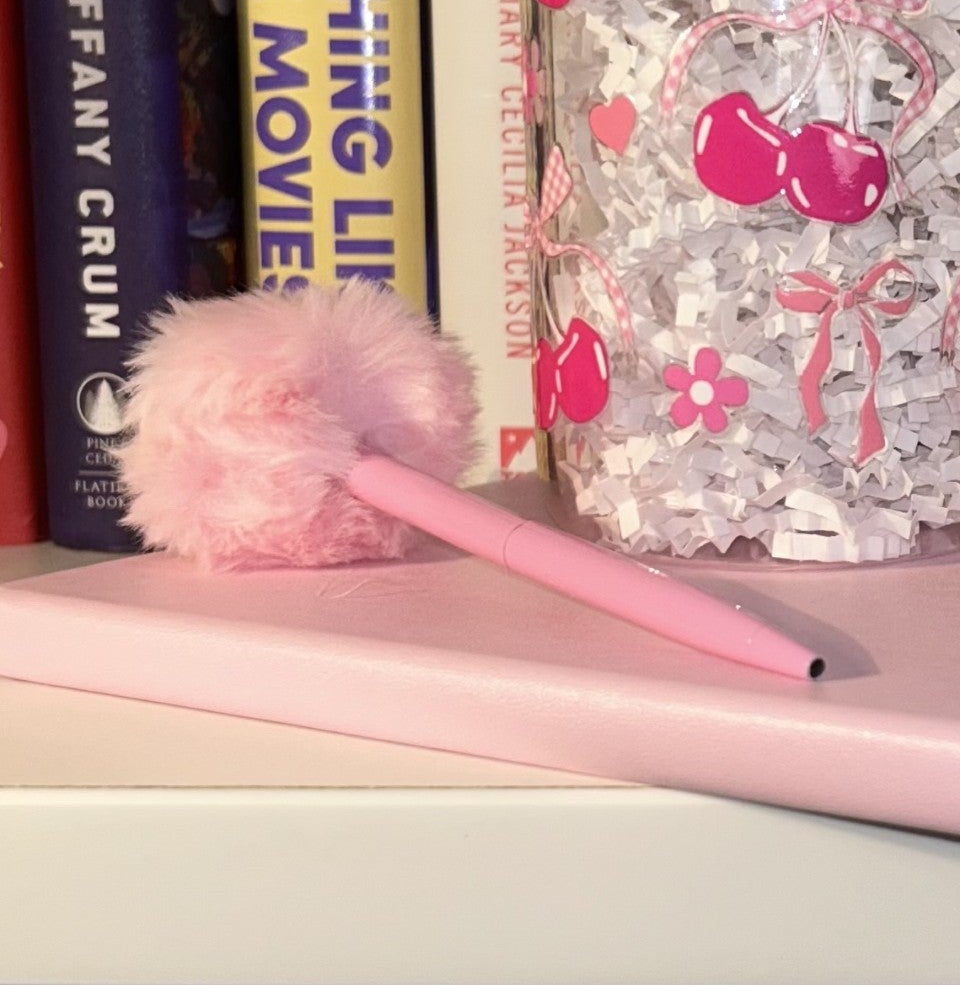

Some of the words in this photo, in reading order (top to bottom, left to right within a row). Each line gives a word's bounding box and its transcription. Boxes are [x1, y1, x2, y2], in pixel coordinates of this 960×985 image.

[501, 86, 527, 208] CECILIA
[76, 188, 122, 339] CRUM
[333, 199, 396, 295] LIK
[503, 223, 534, 359] JACKSON
